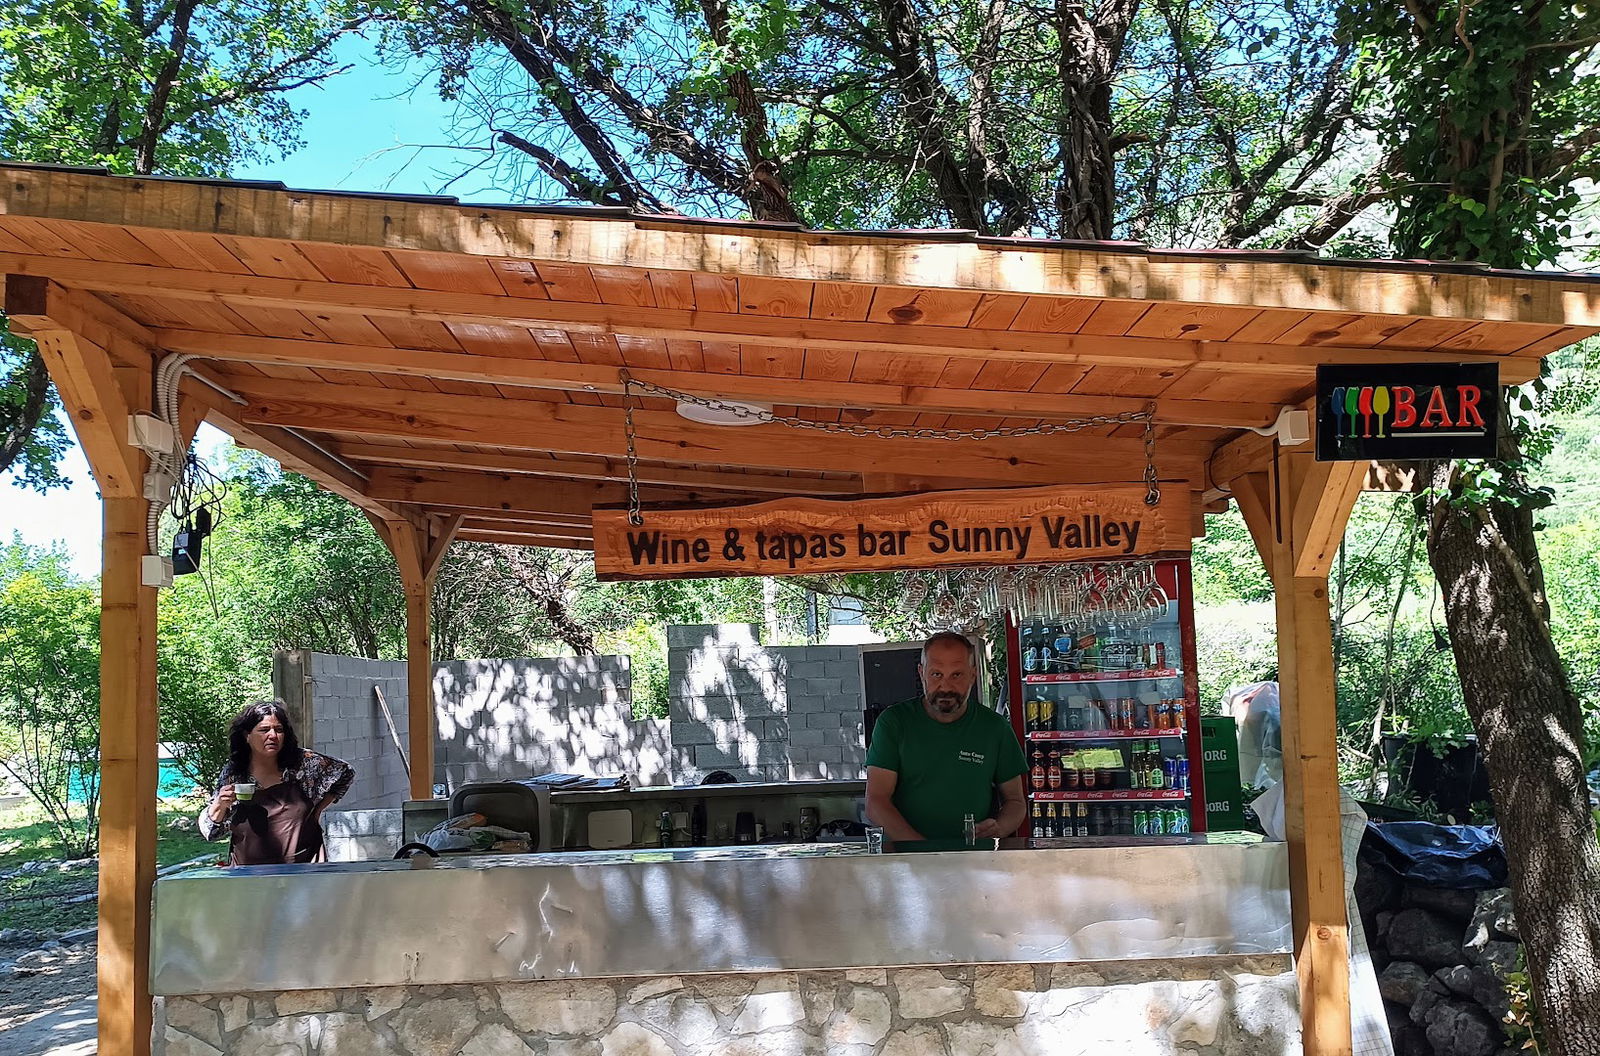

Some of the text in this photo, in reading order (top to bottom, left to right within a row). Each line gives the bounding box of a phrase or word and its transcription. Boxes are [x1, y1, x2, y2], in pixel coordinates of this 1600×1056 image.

[1391, 385, 1485, 428] BAR
[627, 514, 1141, 568] Wine & tapas bar Sunny Valley
